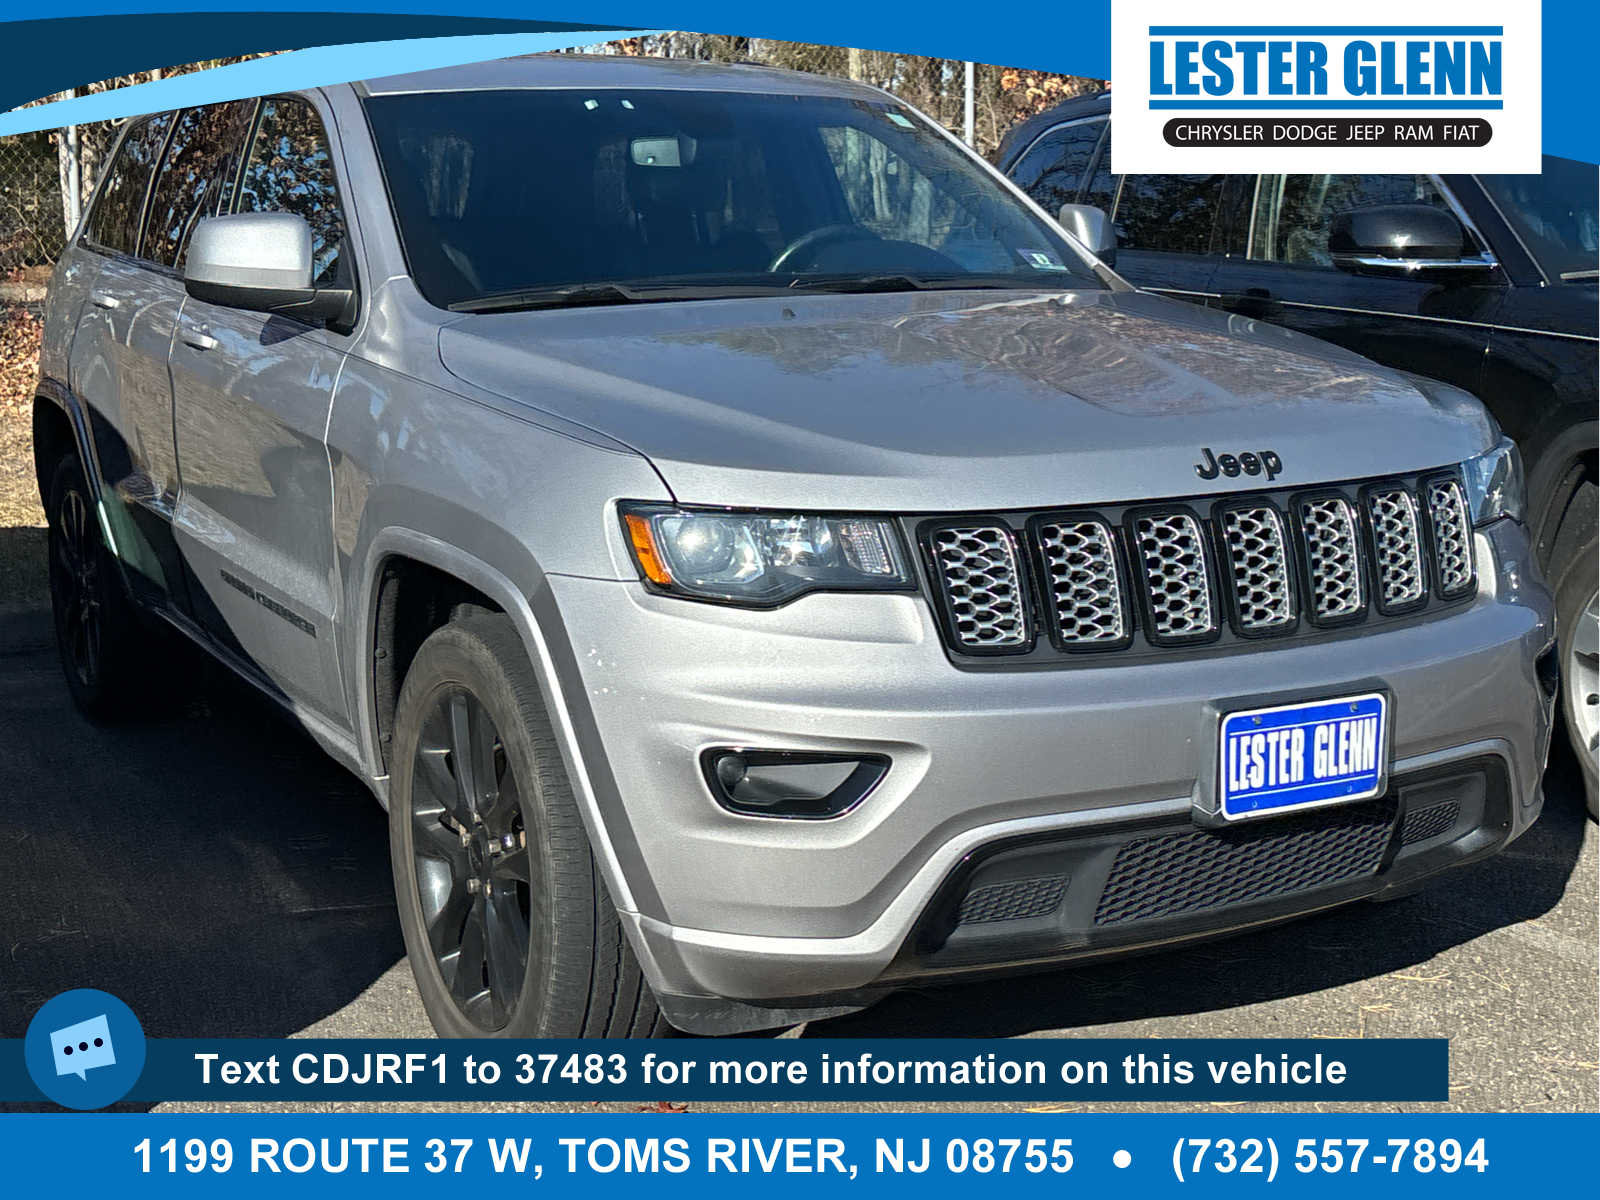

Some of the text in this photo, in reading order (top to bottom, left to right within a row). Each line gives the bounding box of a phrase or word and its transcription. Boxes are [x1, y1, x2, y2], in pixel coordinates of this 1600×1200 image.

[1193, 447, 1283, 481] Jeep
[1229, 717, 1378, 792] LESTER GLENN
